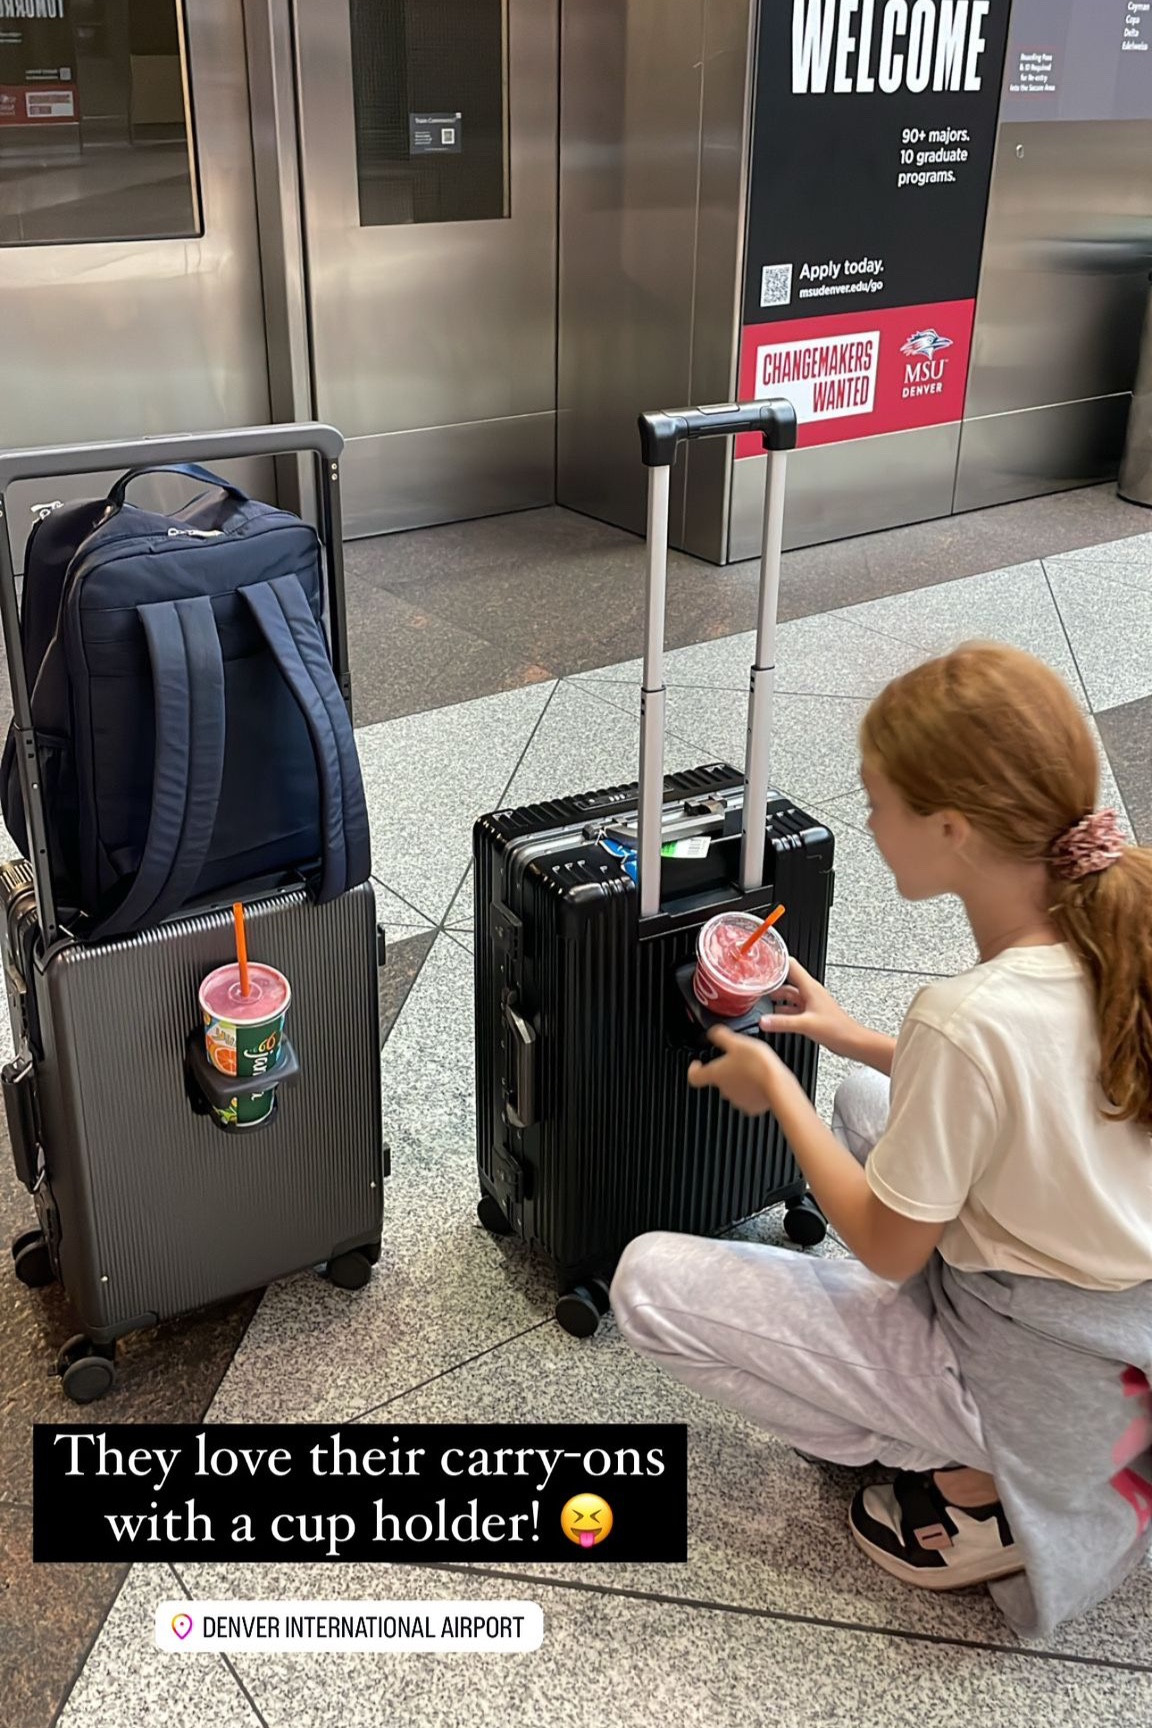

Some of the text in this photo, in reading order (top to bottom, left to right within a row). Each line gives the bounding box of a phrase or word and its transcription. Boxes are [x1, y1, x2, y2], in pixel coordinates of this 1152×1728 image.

[1127, 1, 1151, 13] Cayman
[1125, 14, 1141, 26] Copa
[1123, 27, 1140, 38] Delta
[792, 0, 990, 94] WELCOME
[1121, 40, 1149, 51] Edelweiss
[1020, 53, 1053, 63] Boarding Pass
[1030, 63, 1052, 73] Required
[1020, 84, 1029, 92] the
[1029, 84, 1044, 92] Secure
[1044, 84, 1056, 92] Area
[901, 126, 970, 145] 90+ majors.
[900, 147, 969, 167] 10 graduate
[897, 170, 956, 188] programs.
[799, 257, 885, 281] Apply today.
[799, 279, 884, 299] msudenver.edu/go
[762, 340, 874, 386] CHANGEMAKERS
[812, 375, 870, 413] WANTED
[901, 382, 943, 399] DENVER
